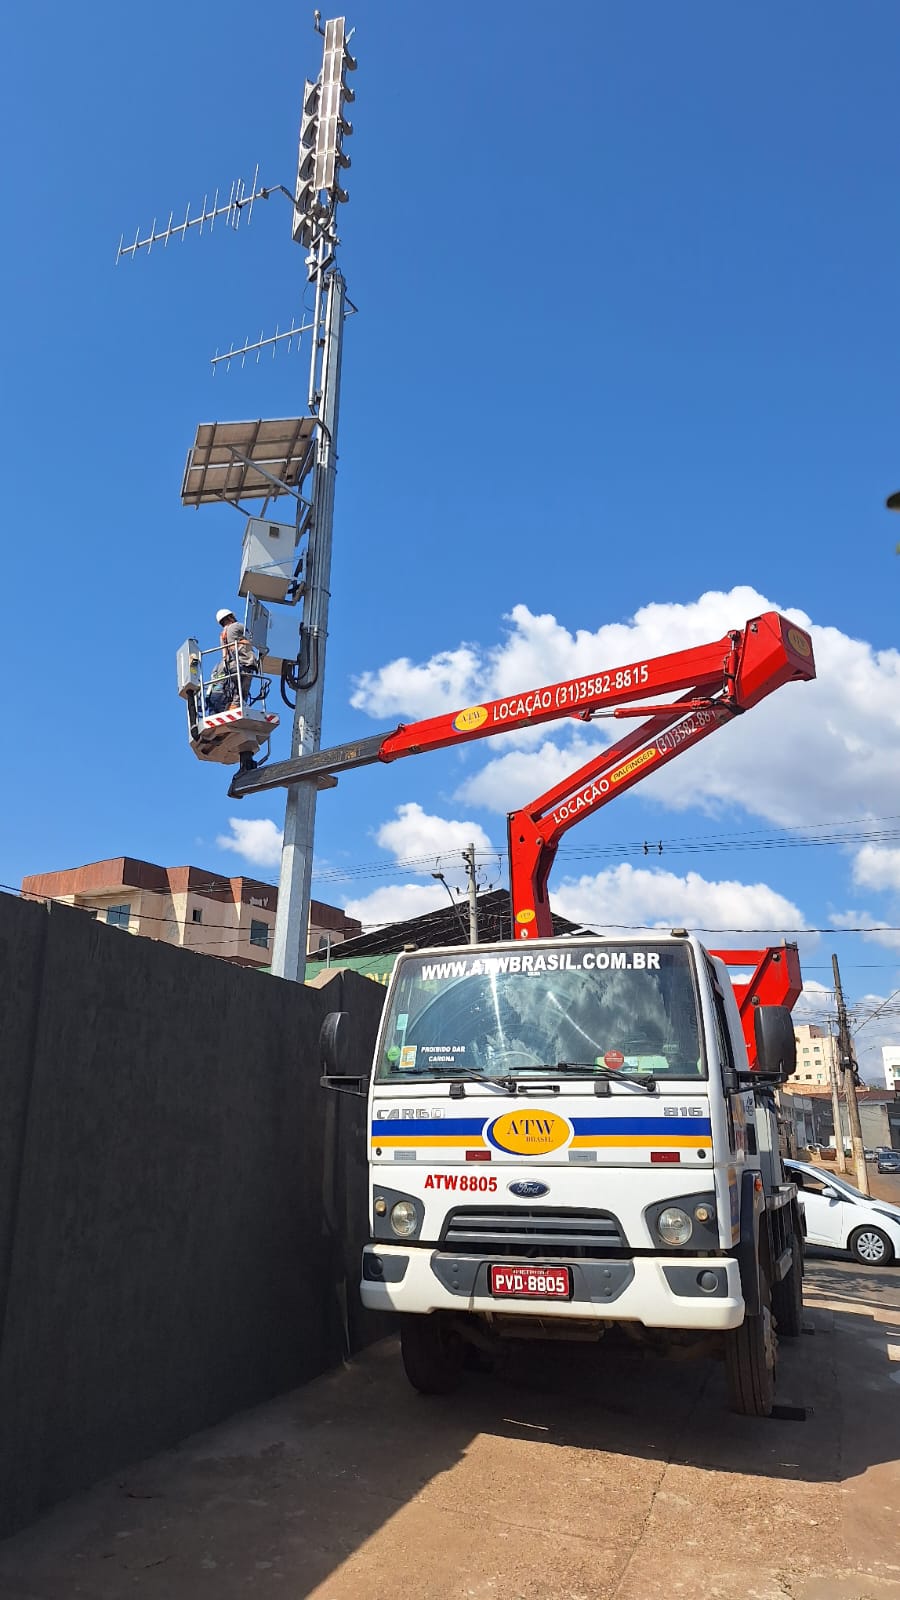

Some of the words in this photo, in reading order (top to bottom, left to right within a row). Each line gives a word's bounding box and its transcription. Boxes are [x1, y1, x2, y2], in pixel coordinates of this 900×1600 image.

[493, 690, 552, 721] LOCAÇÃO
[555, 664, 649, 708] (31)3582-8815
[553, 779, 610, 824] LOCAÇÃO
[613, 750, 654, 780] PALFINGER
[376, 1108, 446, 1119] CARGO
[663, 1106, 703, 1116] 816
[505, 1119, 555, 1135] ATW
[424, 1174, 498, 1192] ATW8805
[517, 1181, 540, 1194] Ford
